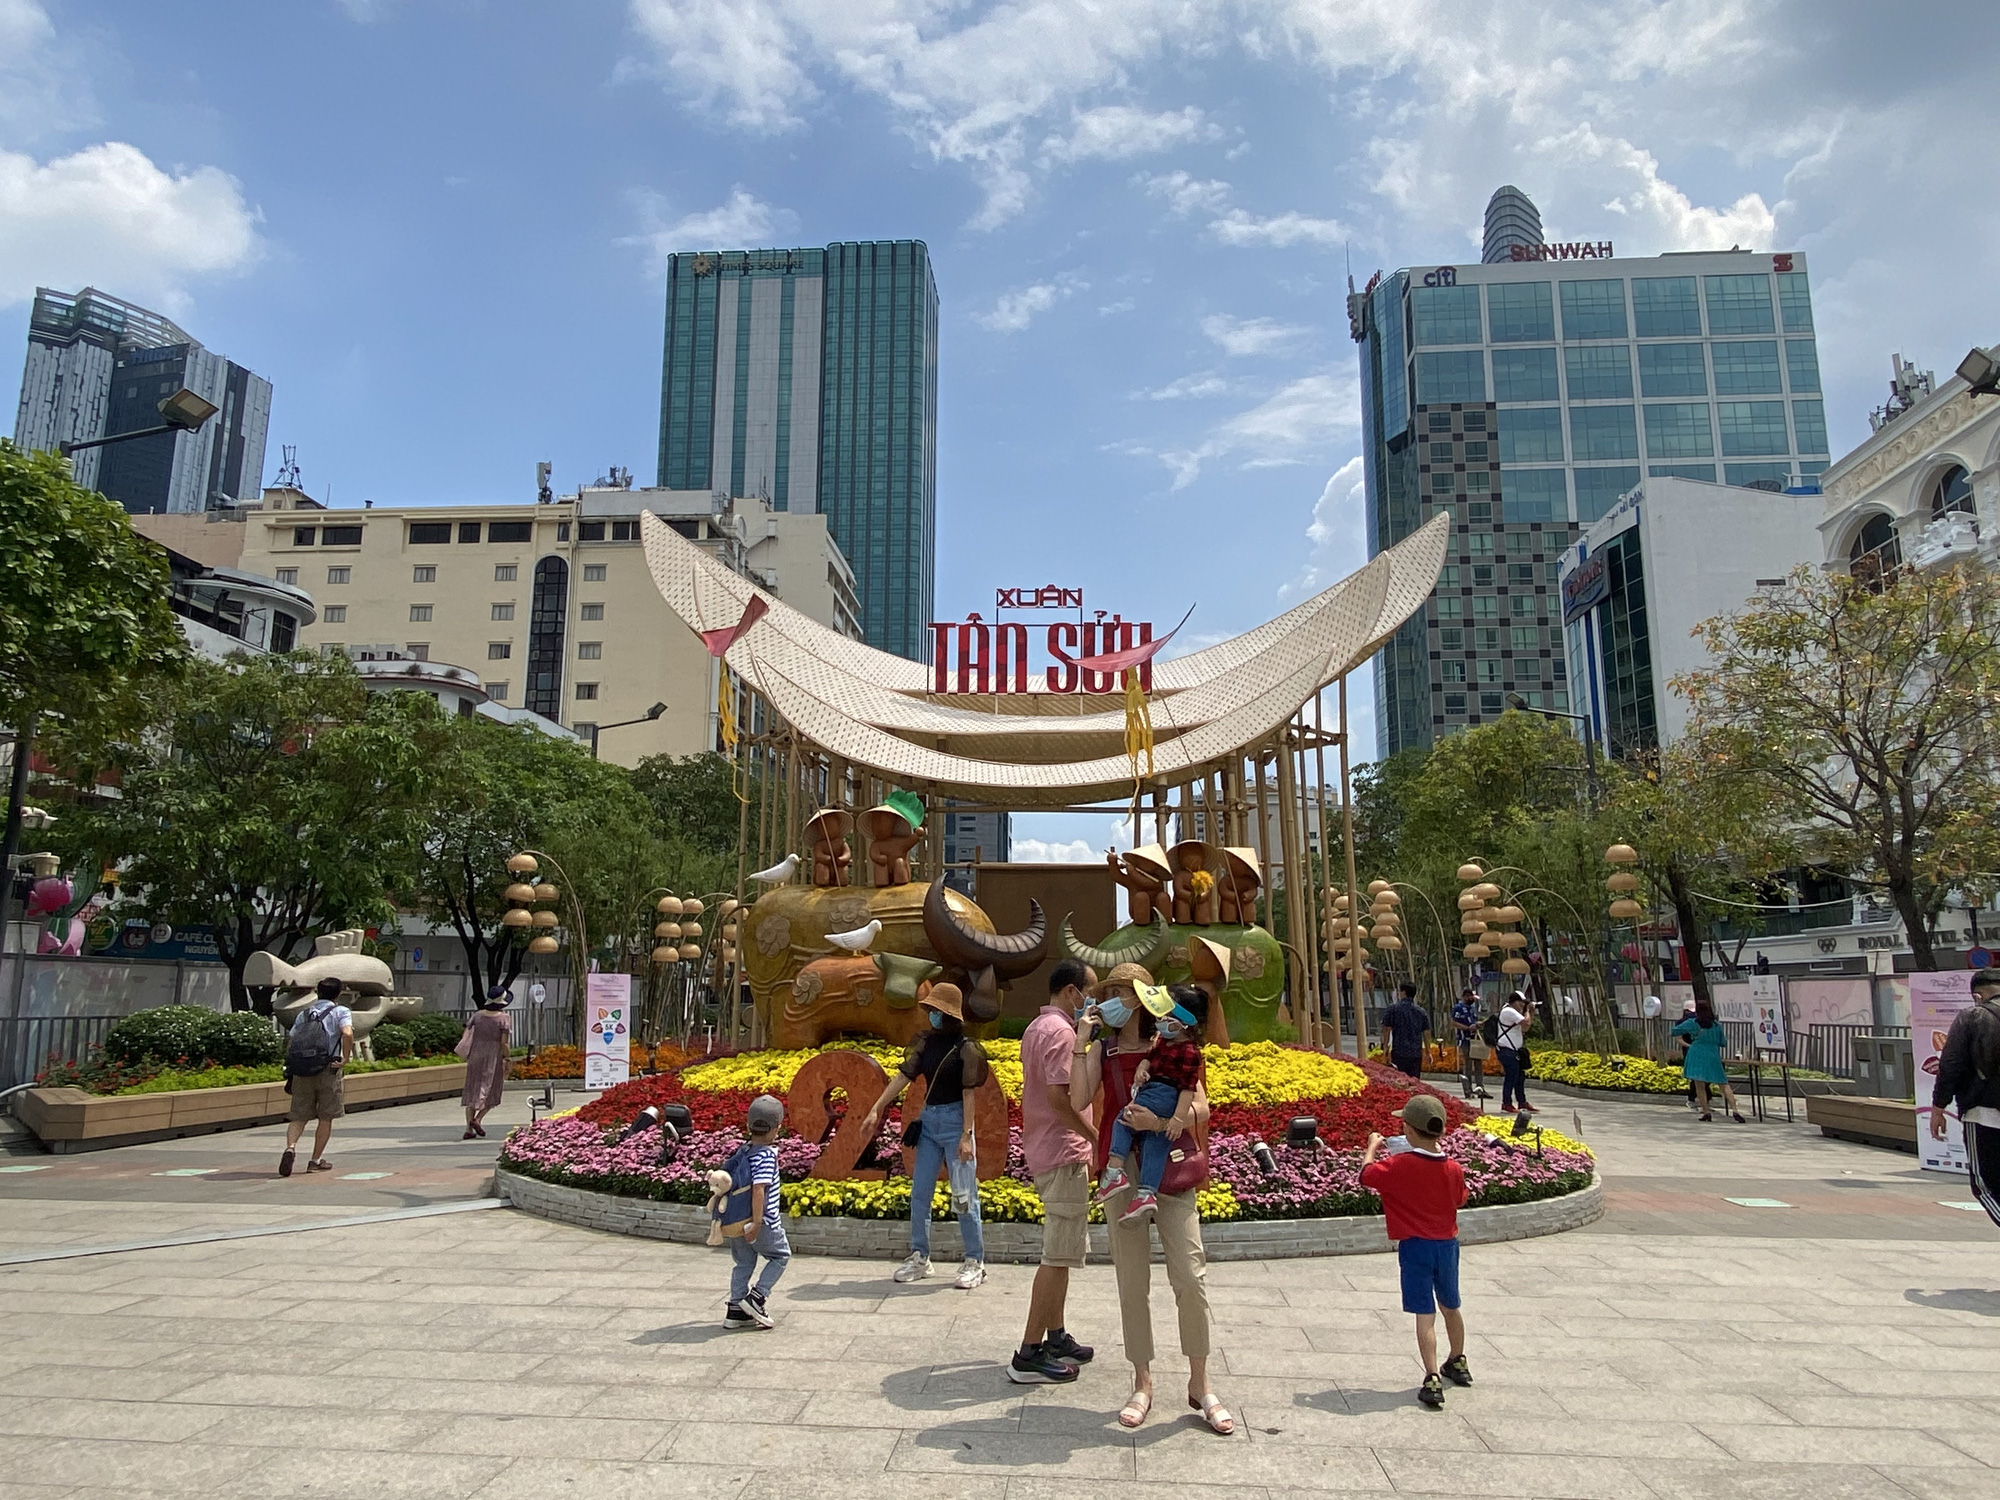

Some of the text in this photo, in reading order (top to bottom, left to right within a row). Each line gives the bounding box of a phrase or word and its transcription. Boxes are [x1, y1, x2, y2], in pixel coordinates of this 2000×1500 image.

[1509, 241, 1614, 262] SUNWAH
[996, 584, 1083, 607] XUÂN
[928, 612, 1028, 694] TÂN
[1857, 933, 1905, 950] ROYAL
